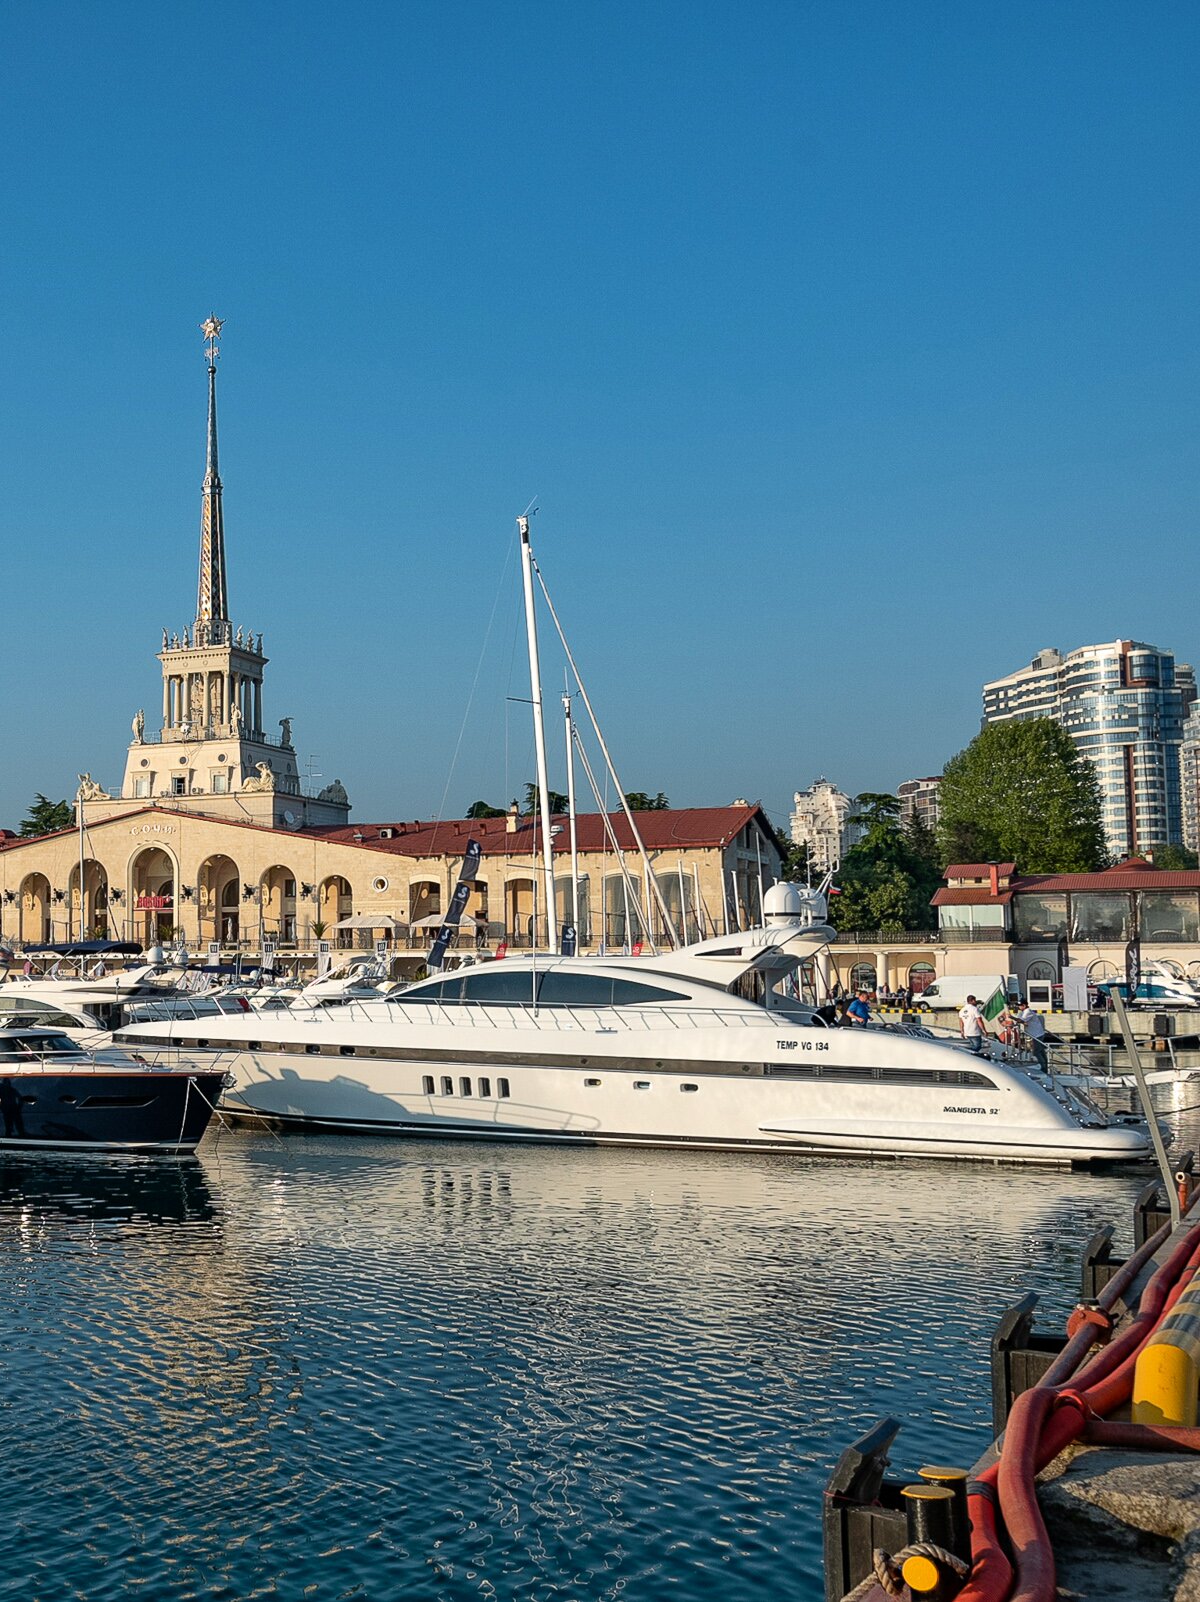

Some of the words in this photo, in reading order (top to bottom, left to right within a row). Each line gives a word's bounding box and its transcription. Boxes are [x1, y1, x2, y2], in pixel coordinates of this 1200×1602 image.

[776, 1040, 798, 1049] TEMP
[801, 1041, 812, 1050] VG
[815, 1042, 829, 1050] 134
[943, 1106, 986, 1114] MANGUSTA
